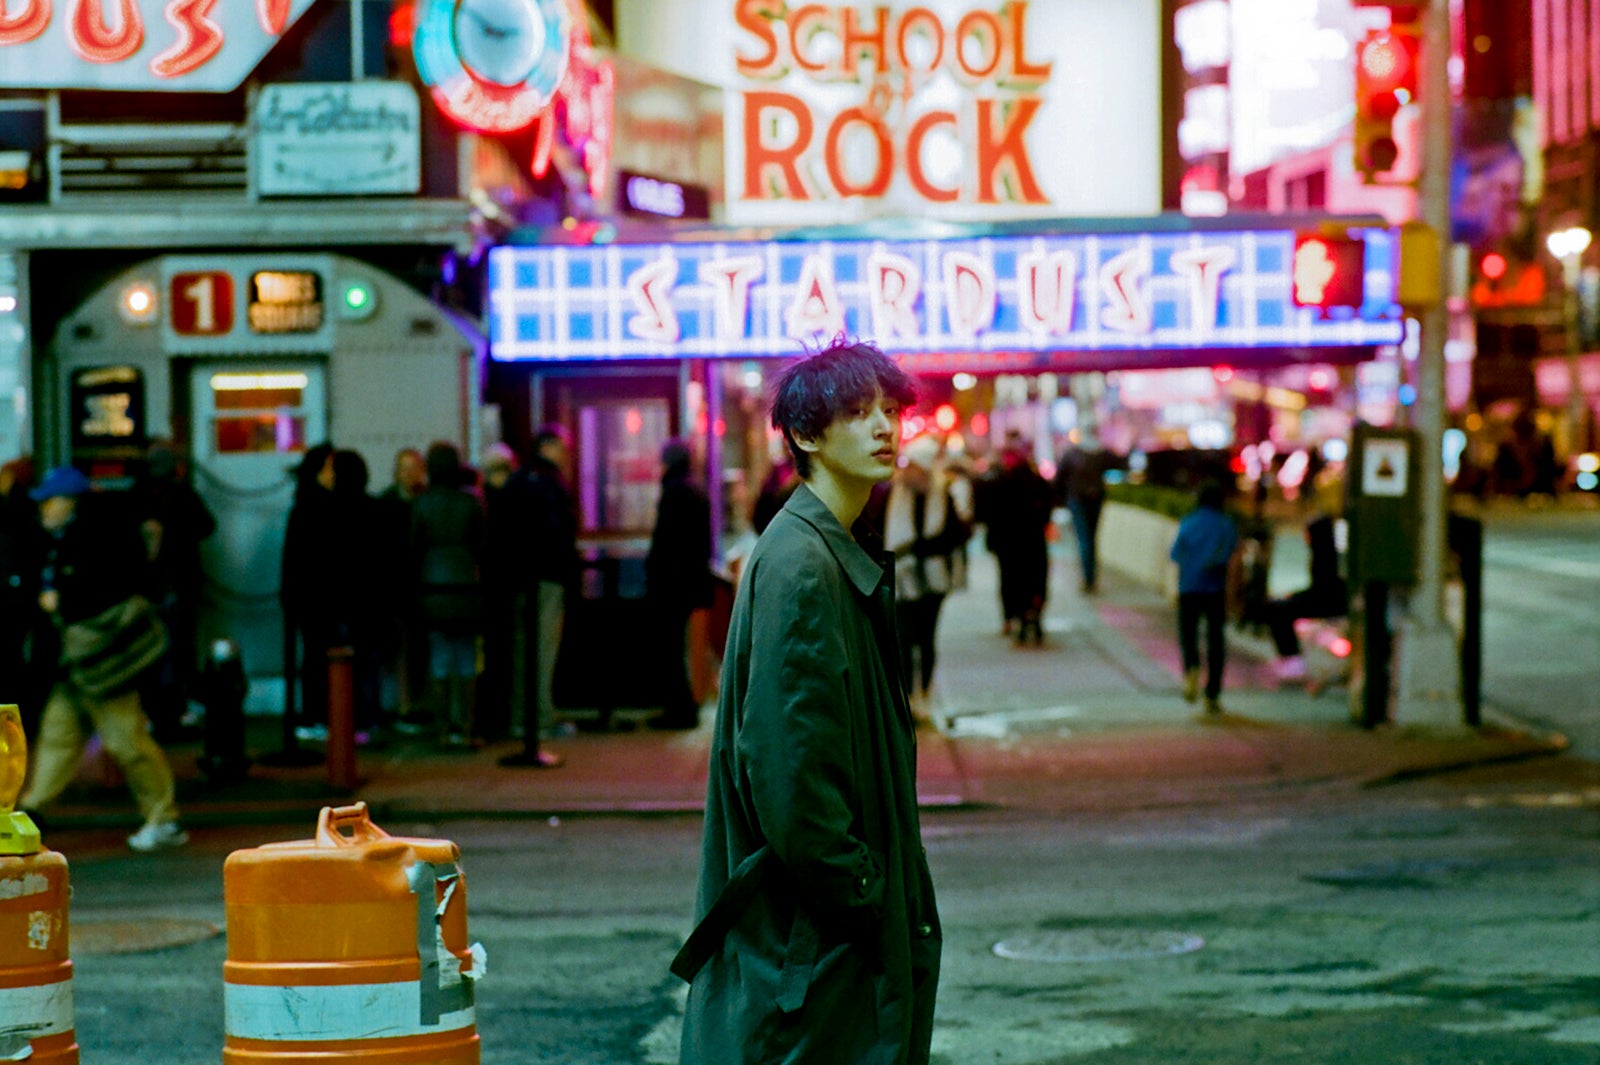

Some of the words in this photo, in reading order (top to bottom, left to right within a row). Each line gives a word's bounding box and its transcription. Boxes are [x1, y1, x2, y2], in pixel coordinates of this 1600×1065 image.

[734, 0, 1053, 80] SCHOOL
[741, 91, 1050, 204] ROCK
[184, 275, 215, 331] 1
[626, 245, 1236, 343] STARDUST
